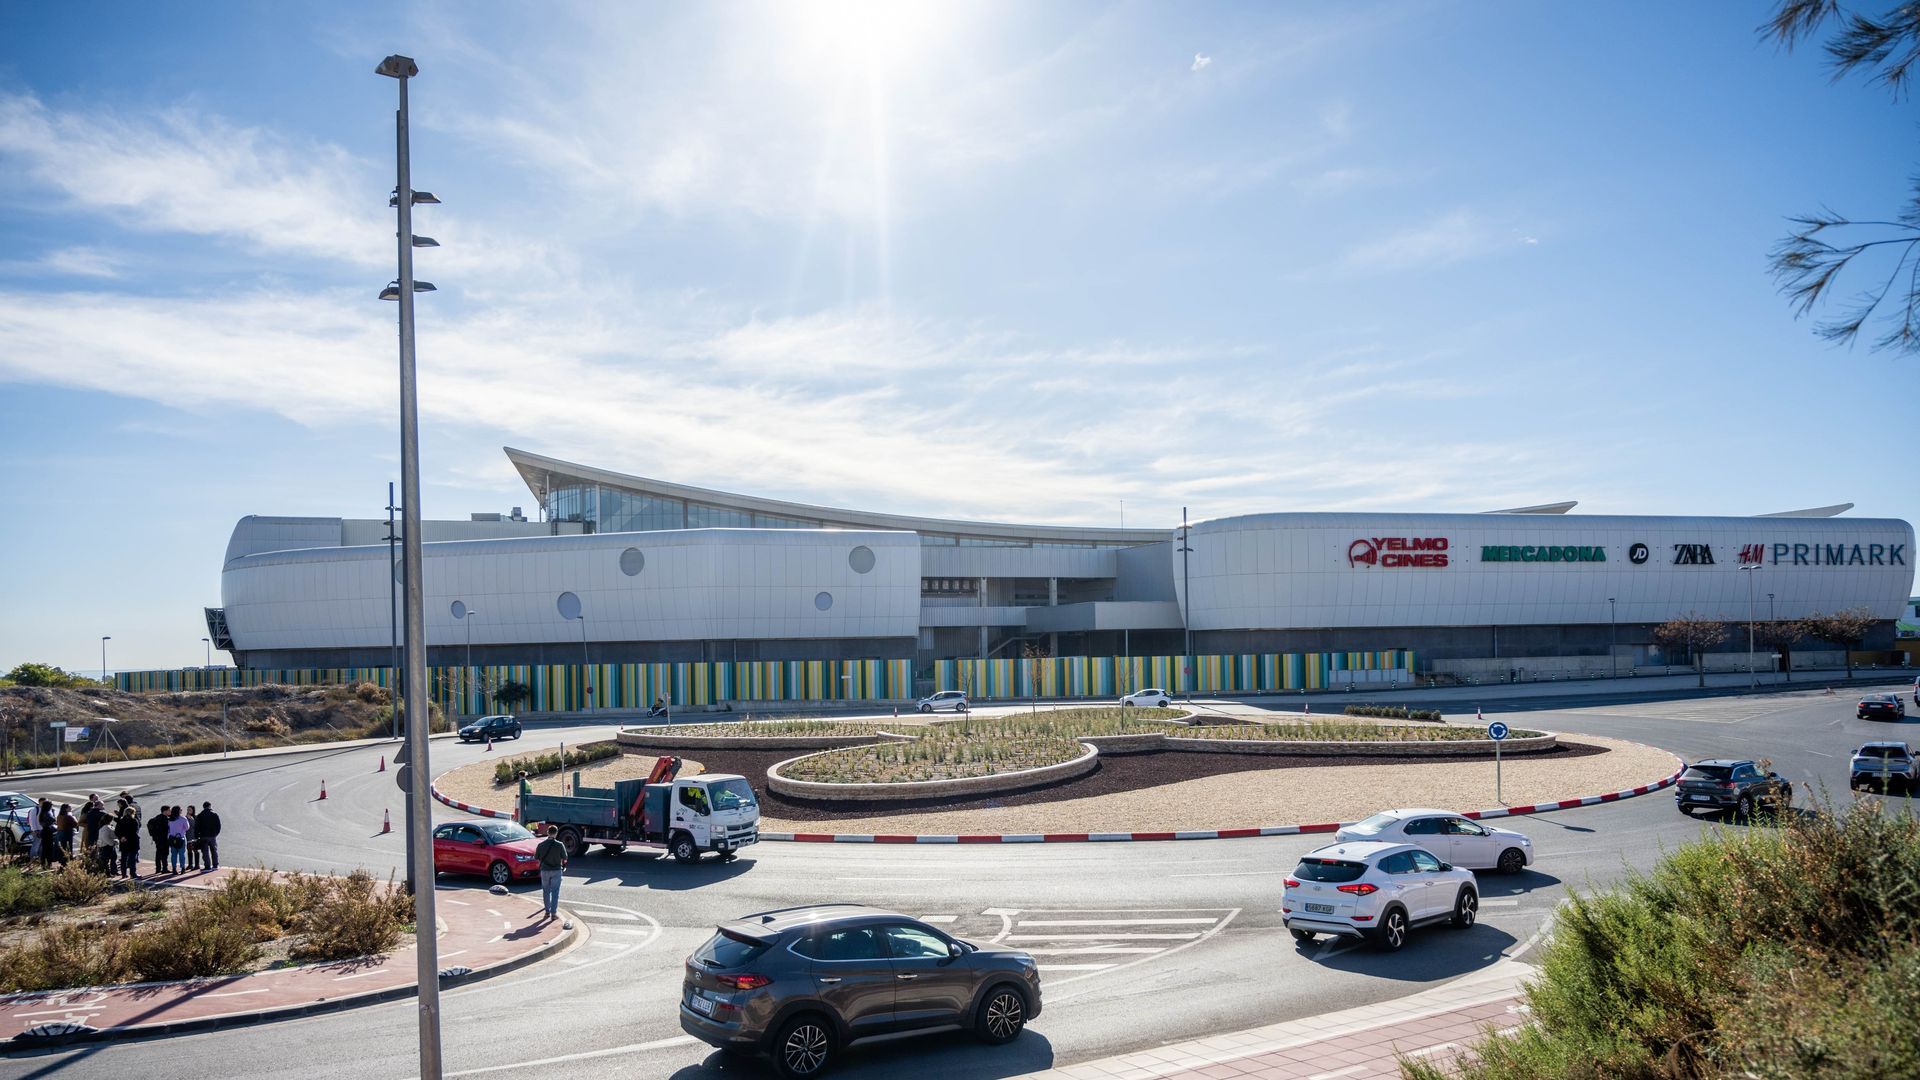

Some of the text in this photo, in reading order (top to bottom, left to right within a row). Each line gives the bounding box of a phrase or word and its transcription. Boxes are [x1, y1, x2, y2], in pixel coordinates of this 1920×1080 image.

[1372, 537, 1448, 550] YELMO
[1382, 554, 1448, 567] CINES
[1481, 546, 1606, 561] MERCADONA
[1673, 544, 1714, 564] ZARA
[1738, 543, 1764, 565] H&M
[1774, 543, 1905, 565] PRIMARK
